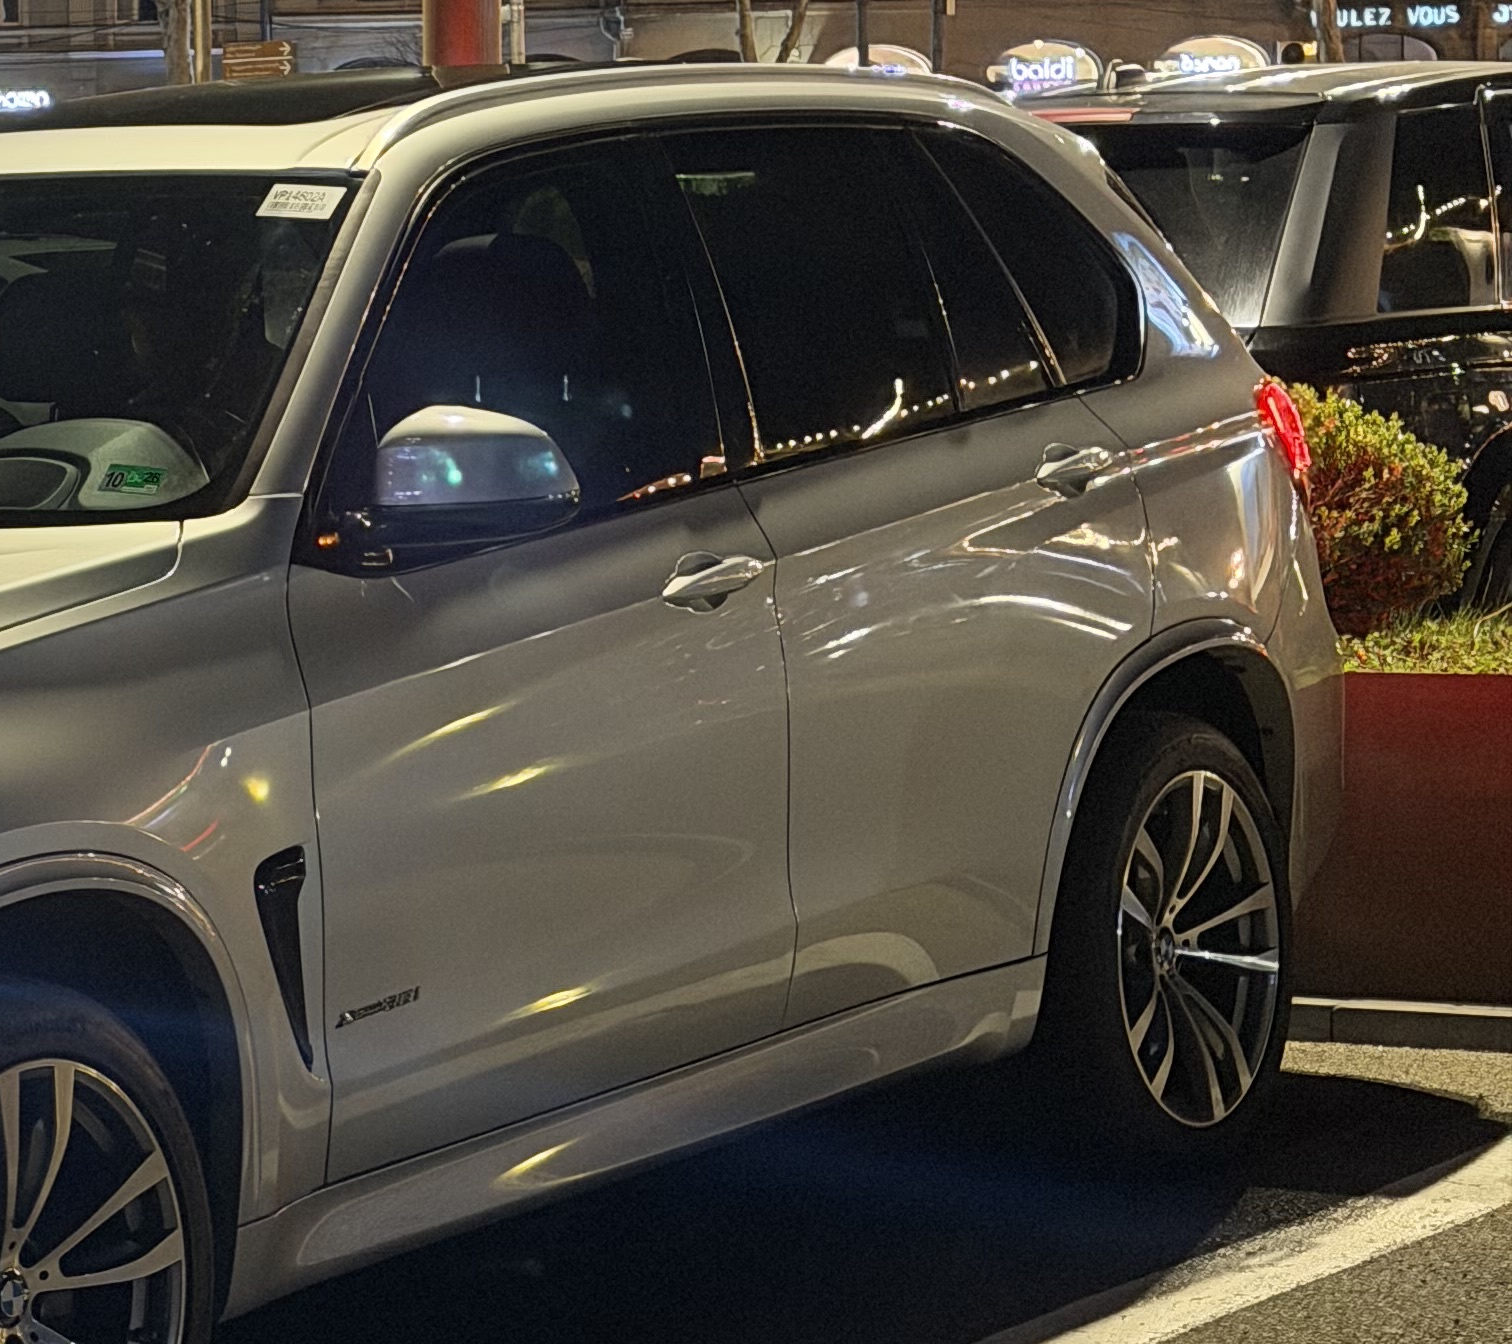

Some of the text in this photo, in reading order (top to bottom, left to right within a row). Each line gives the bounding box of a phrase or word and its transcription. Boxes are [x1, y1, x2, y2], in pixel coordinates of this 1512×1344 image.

[1310, 4, 1460, 27] ULEZ VOUS
[1010, 56, 1074, 81] baldi
[105, 471, 125, 488] 10
